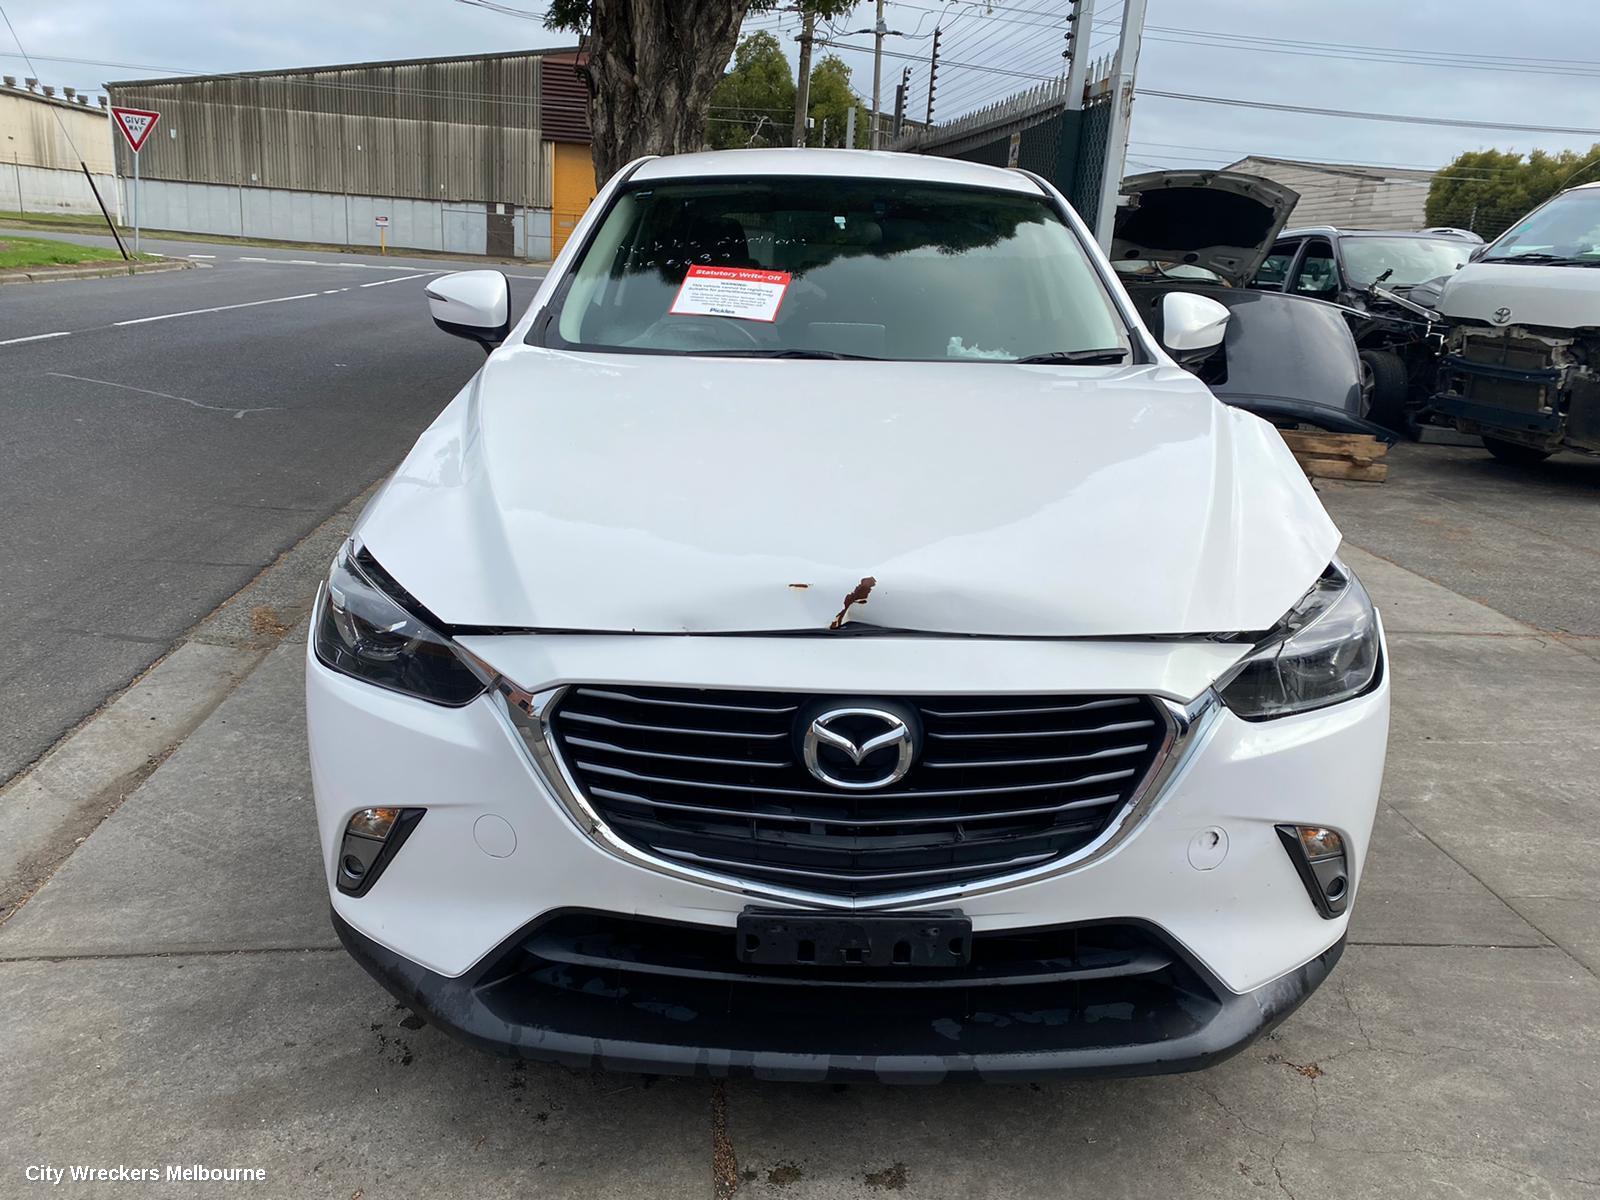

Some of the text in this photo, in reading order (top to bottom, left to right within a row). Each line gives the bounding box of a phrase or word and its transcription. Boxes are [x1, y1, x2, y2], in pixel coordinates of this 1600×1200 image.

[125, 116, 146, 125] GIVE
[696, 269, 782, 280] Statutory Write-Off
